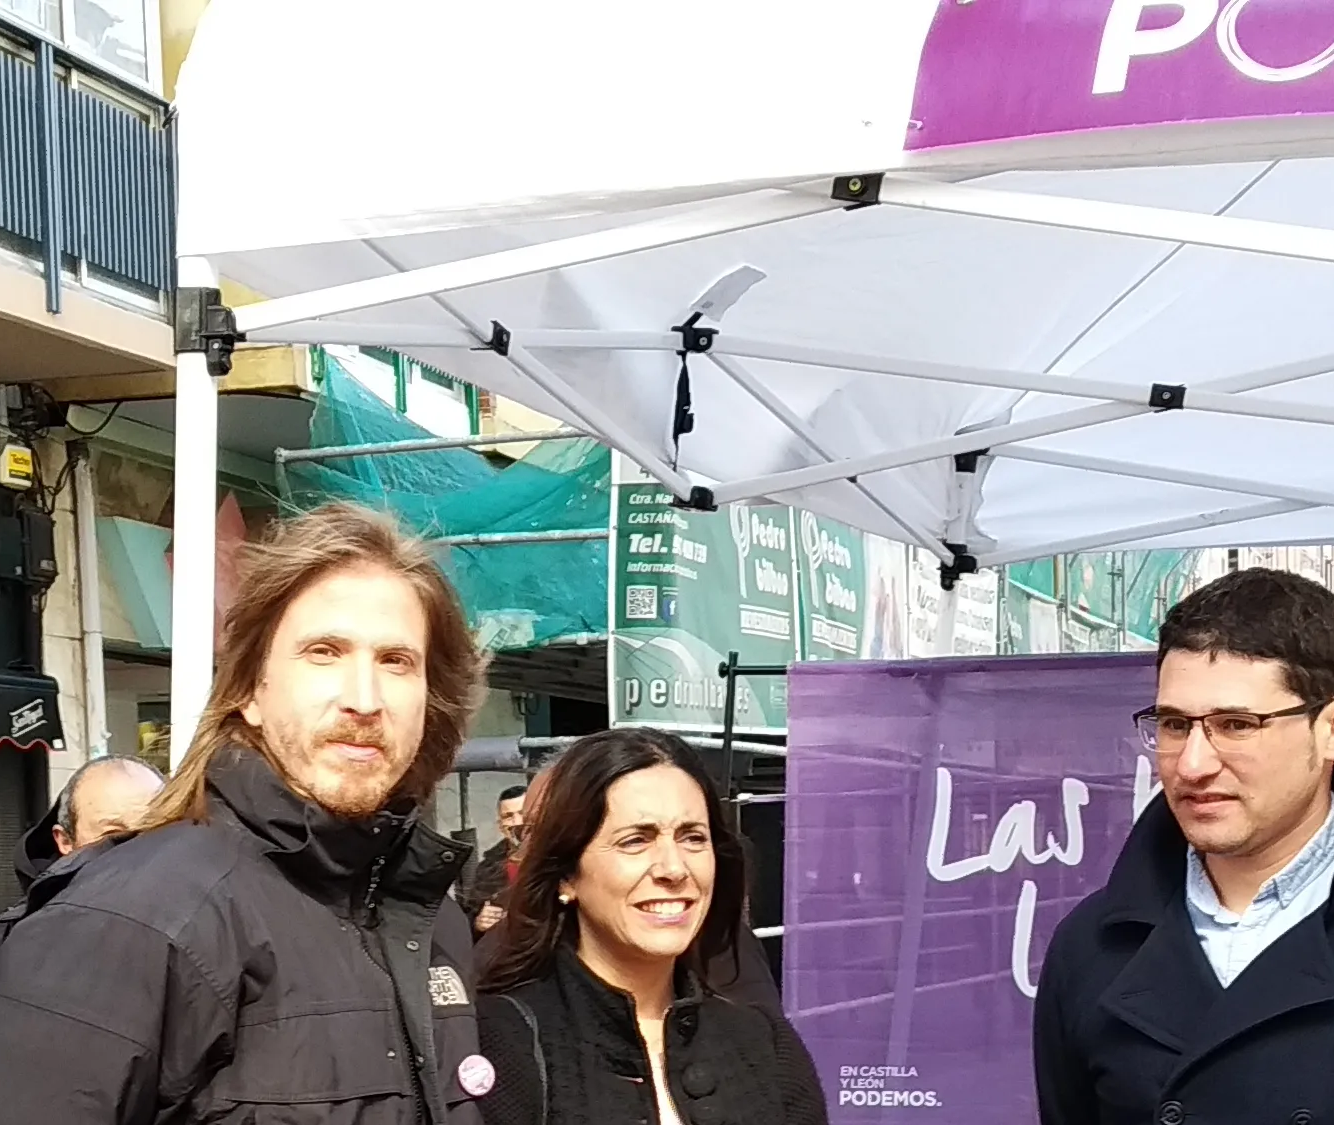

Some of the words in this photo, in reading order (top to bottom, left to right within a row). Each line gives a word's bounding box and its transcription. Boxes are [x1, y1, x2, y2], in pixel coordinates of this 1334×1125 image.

[927, 766, 1089, 882] Las
[840, 1065, 858, 1077] EN
[859, 1065, 919, 1077] CASTILLA
[839, 1077, 850, 1089] Y
[850, 1075, 885, 1089] LEÓN
[839, 1090, 943, 1107] PODEMOS.
